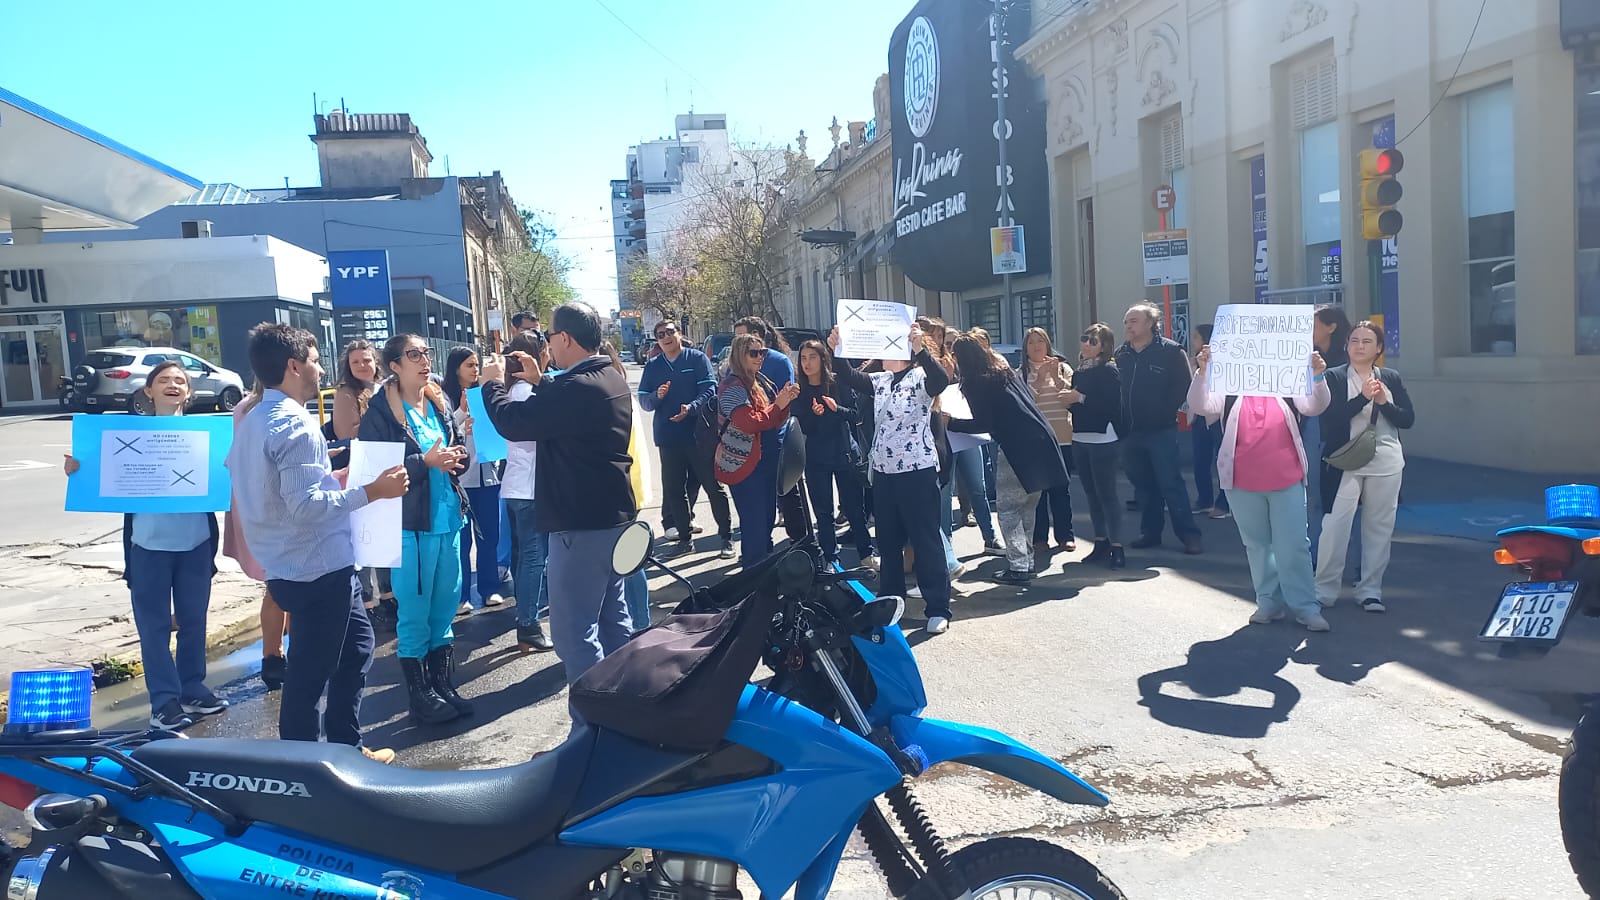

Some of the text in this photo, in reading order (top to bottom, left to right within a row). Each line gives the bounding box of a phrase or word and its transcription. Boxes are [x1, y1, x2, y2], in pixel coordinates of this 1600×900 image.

[911, 142, 963, 206] Ruinas
[995, 165, 1015, 227] BA
[1157, 189, 1169, 208] E
[896, 191, 967, 238] RESTO CAFE BAR
[336, 266, 379, 279] YPF
[1214, 313, 1313, 335] PROFESIONALES
[1210, 338, 1312, 361] DE SALUD
[1209, 361, 1313, 396] PUBLICA
[1509, 595, 1555, 615] A10
[185, 771, 312, 798] HONDA
[276, 843, 355, 875] POLICIA
[239, 868, 309, 897] ENTRE
[295, 865, 324, 882] DE
